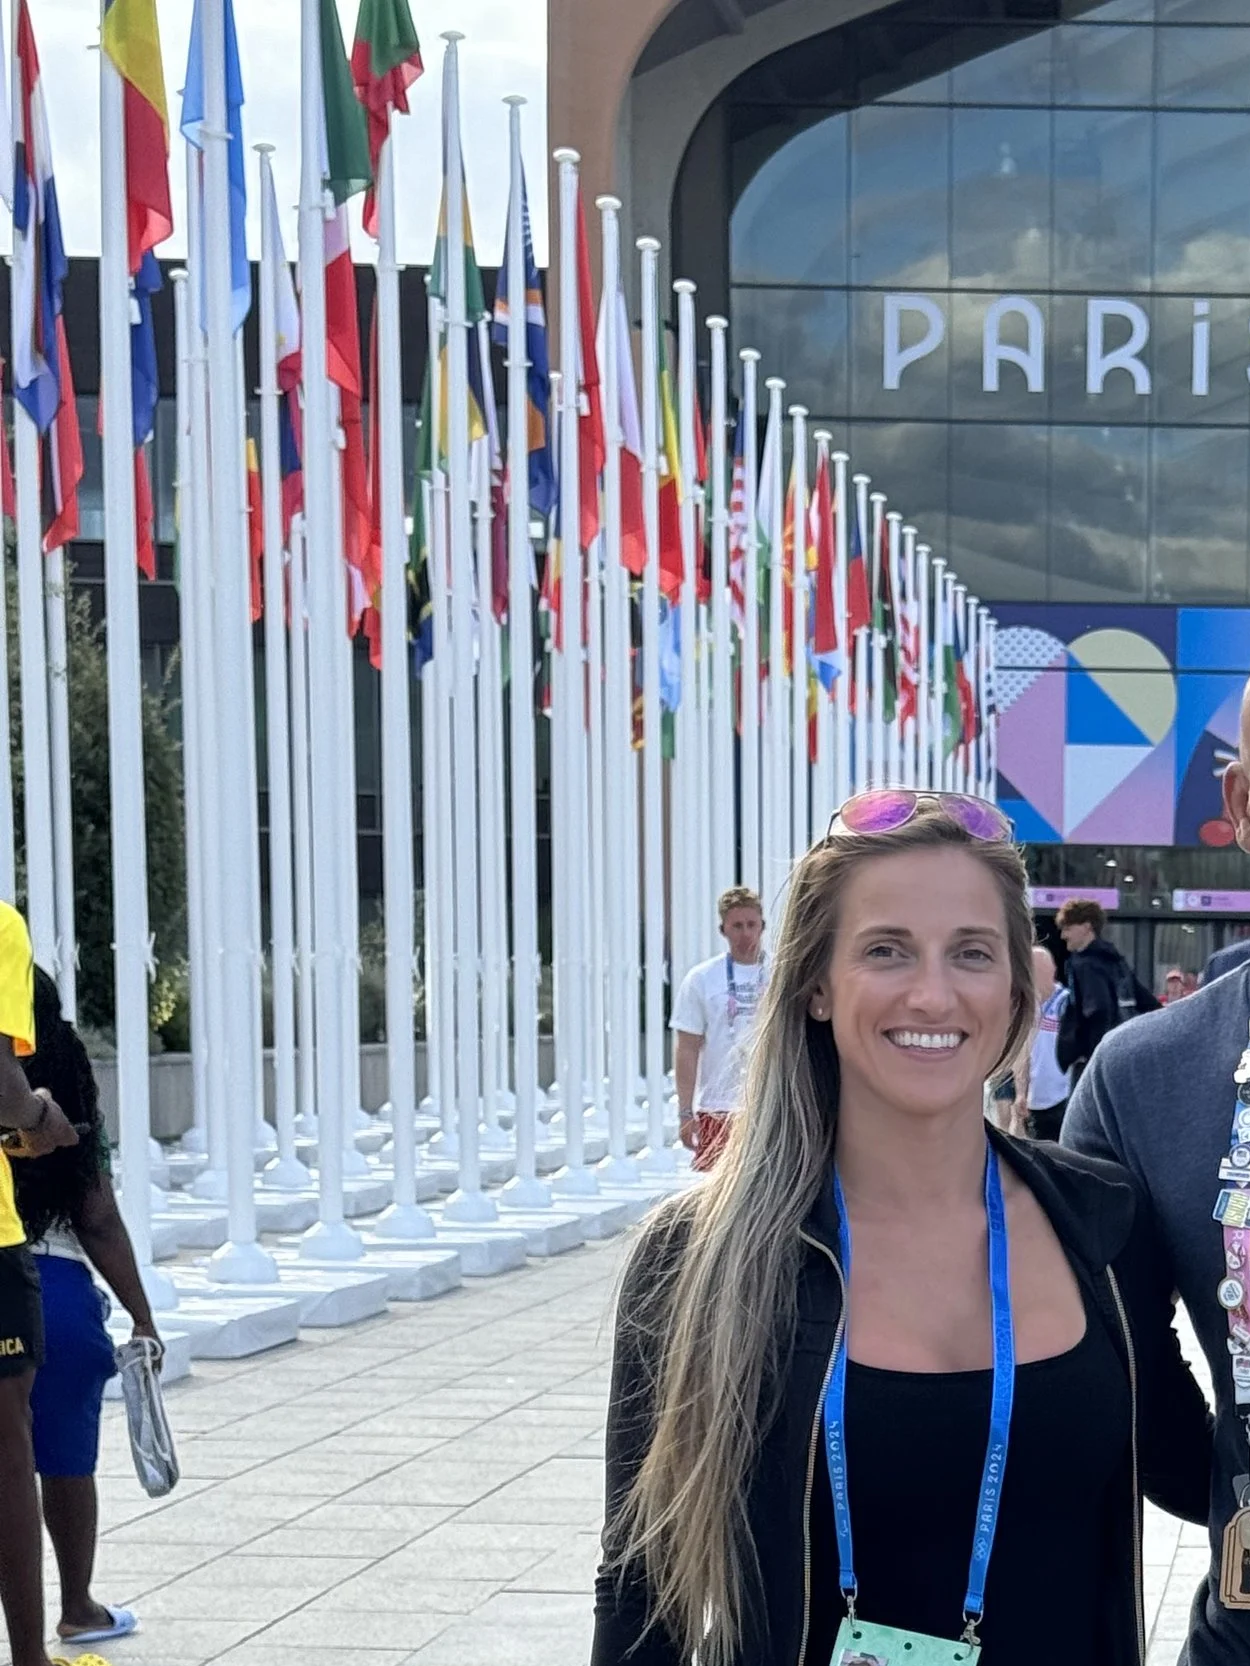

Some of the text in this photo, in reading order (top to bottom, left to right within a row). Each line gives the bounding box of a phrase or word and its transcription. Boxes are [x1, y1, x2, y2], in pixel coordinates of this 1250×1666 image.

[828, 1420, 846, 1511] PARIS 2024
[979, 1443, 1004, 1533] PARIS 2024
